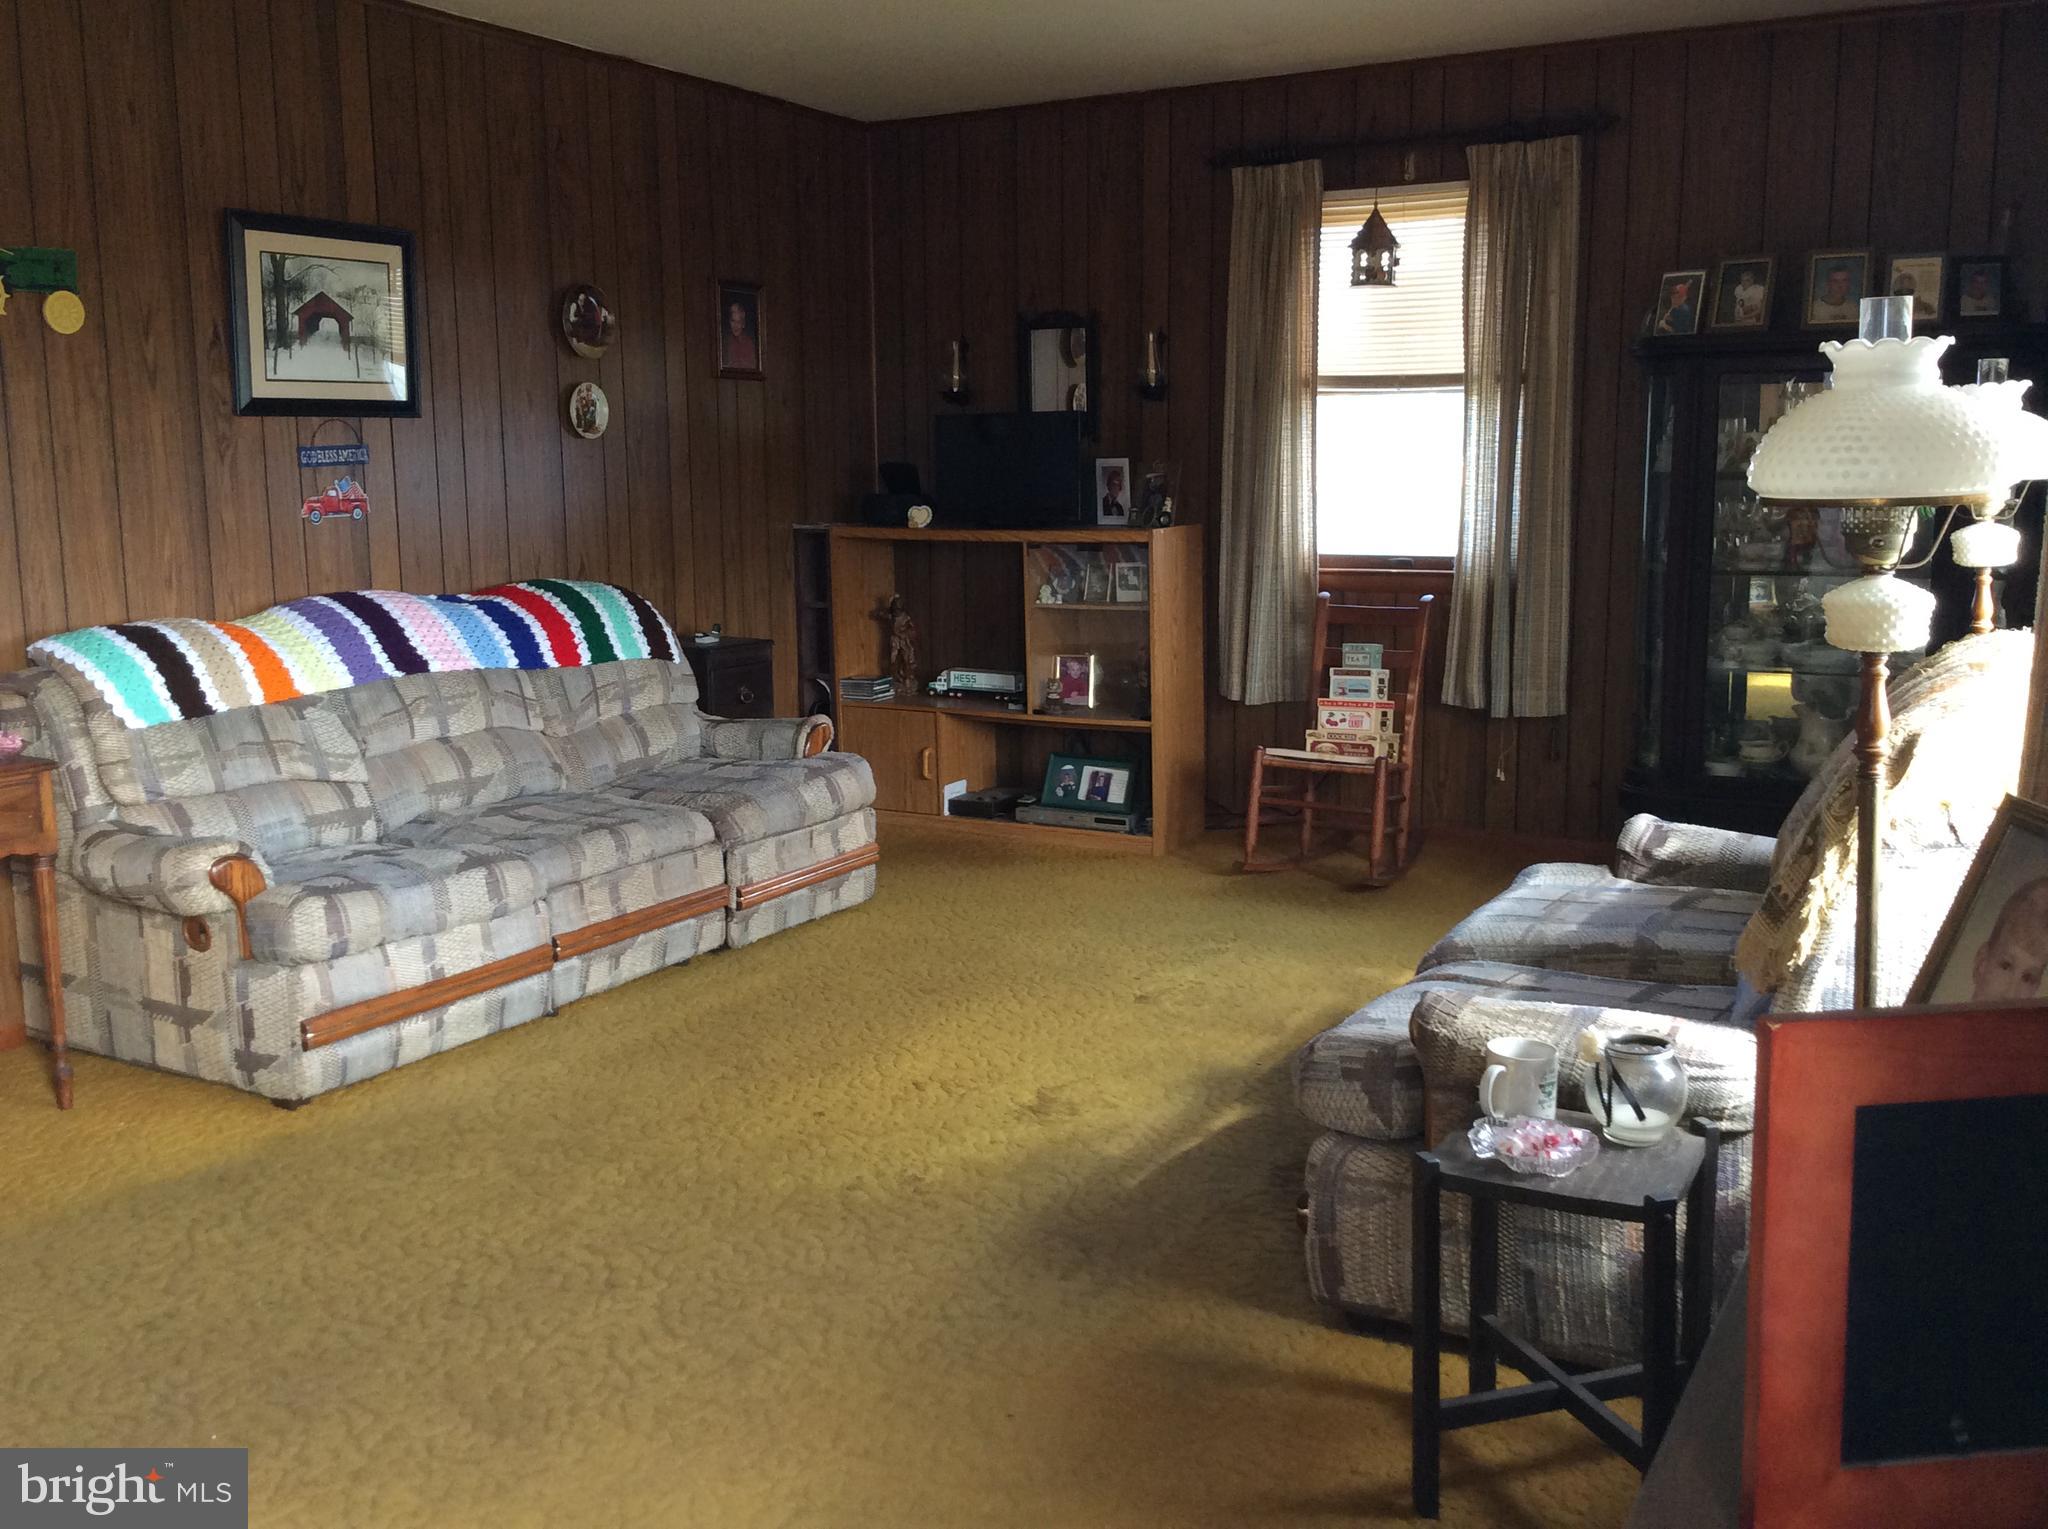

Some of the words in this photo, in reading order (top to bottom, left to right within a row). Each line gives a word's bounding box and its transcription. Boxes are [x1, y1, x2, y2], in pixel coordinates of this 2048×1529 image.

[301, 450, 317, 463] GOD
[317, 449, 338, 462] BLESS
[953, 674, 977, 684] HESS
